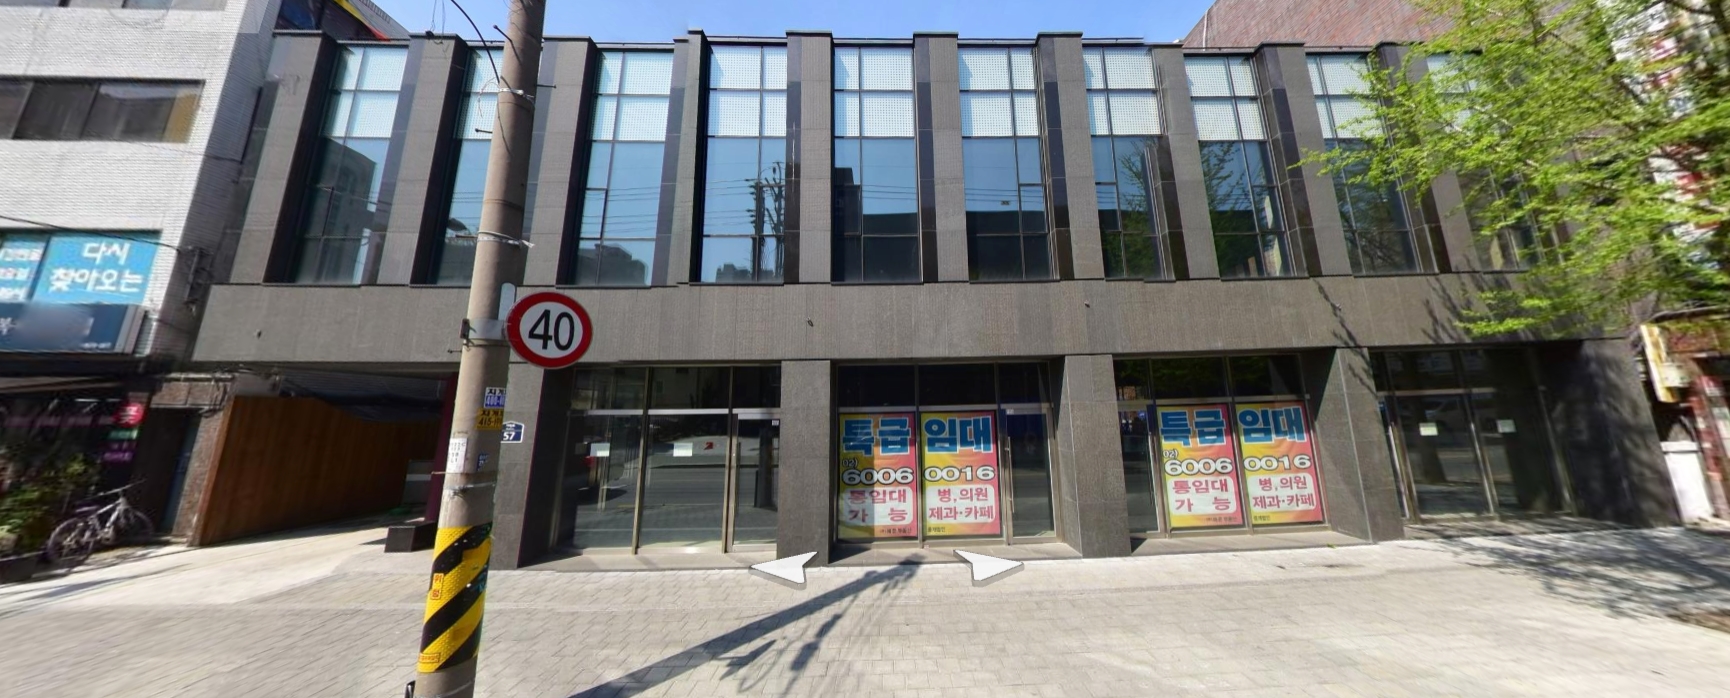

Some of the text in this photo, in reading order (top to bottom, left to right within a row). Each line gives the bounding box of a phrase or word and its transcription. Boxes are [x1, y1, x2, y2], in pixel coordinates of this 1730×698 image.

[82, 242, 130, 265] 다시
[50, 267, 143, 292] 찾아오는
[528, 309, 575, 351] 40
[1160, 409, 1226, 447] 특급
[1238, 406, 1307, 444] 임대
[503, 432, 516, 441] 57
[842, 417, 911, 456] 특급
[924, 416, 993, 454] 임대
[1163, 449, 1178, 458] 02)
[1243, 454, 1312, 472] 0016
[842, 466, 914, 485] 6006
[924, 466, 995, 481] 0016
[1164, 457, 1233, 476] 6006
[848, 489, 907, 504] 통임대
[1172, 479, 1229, 495] 통임대
